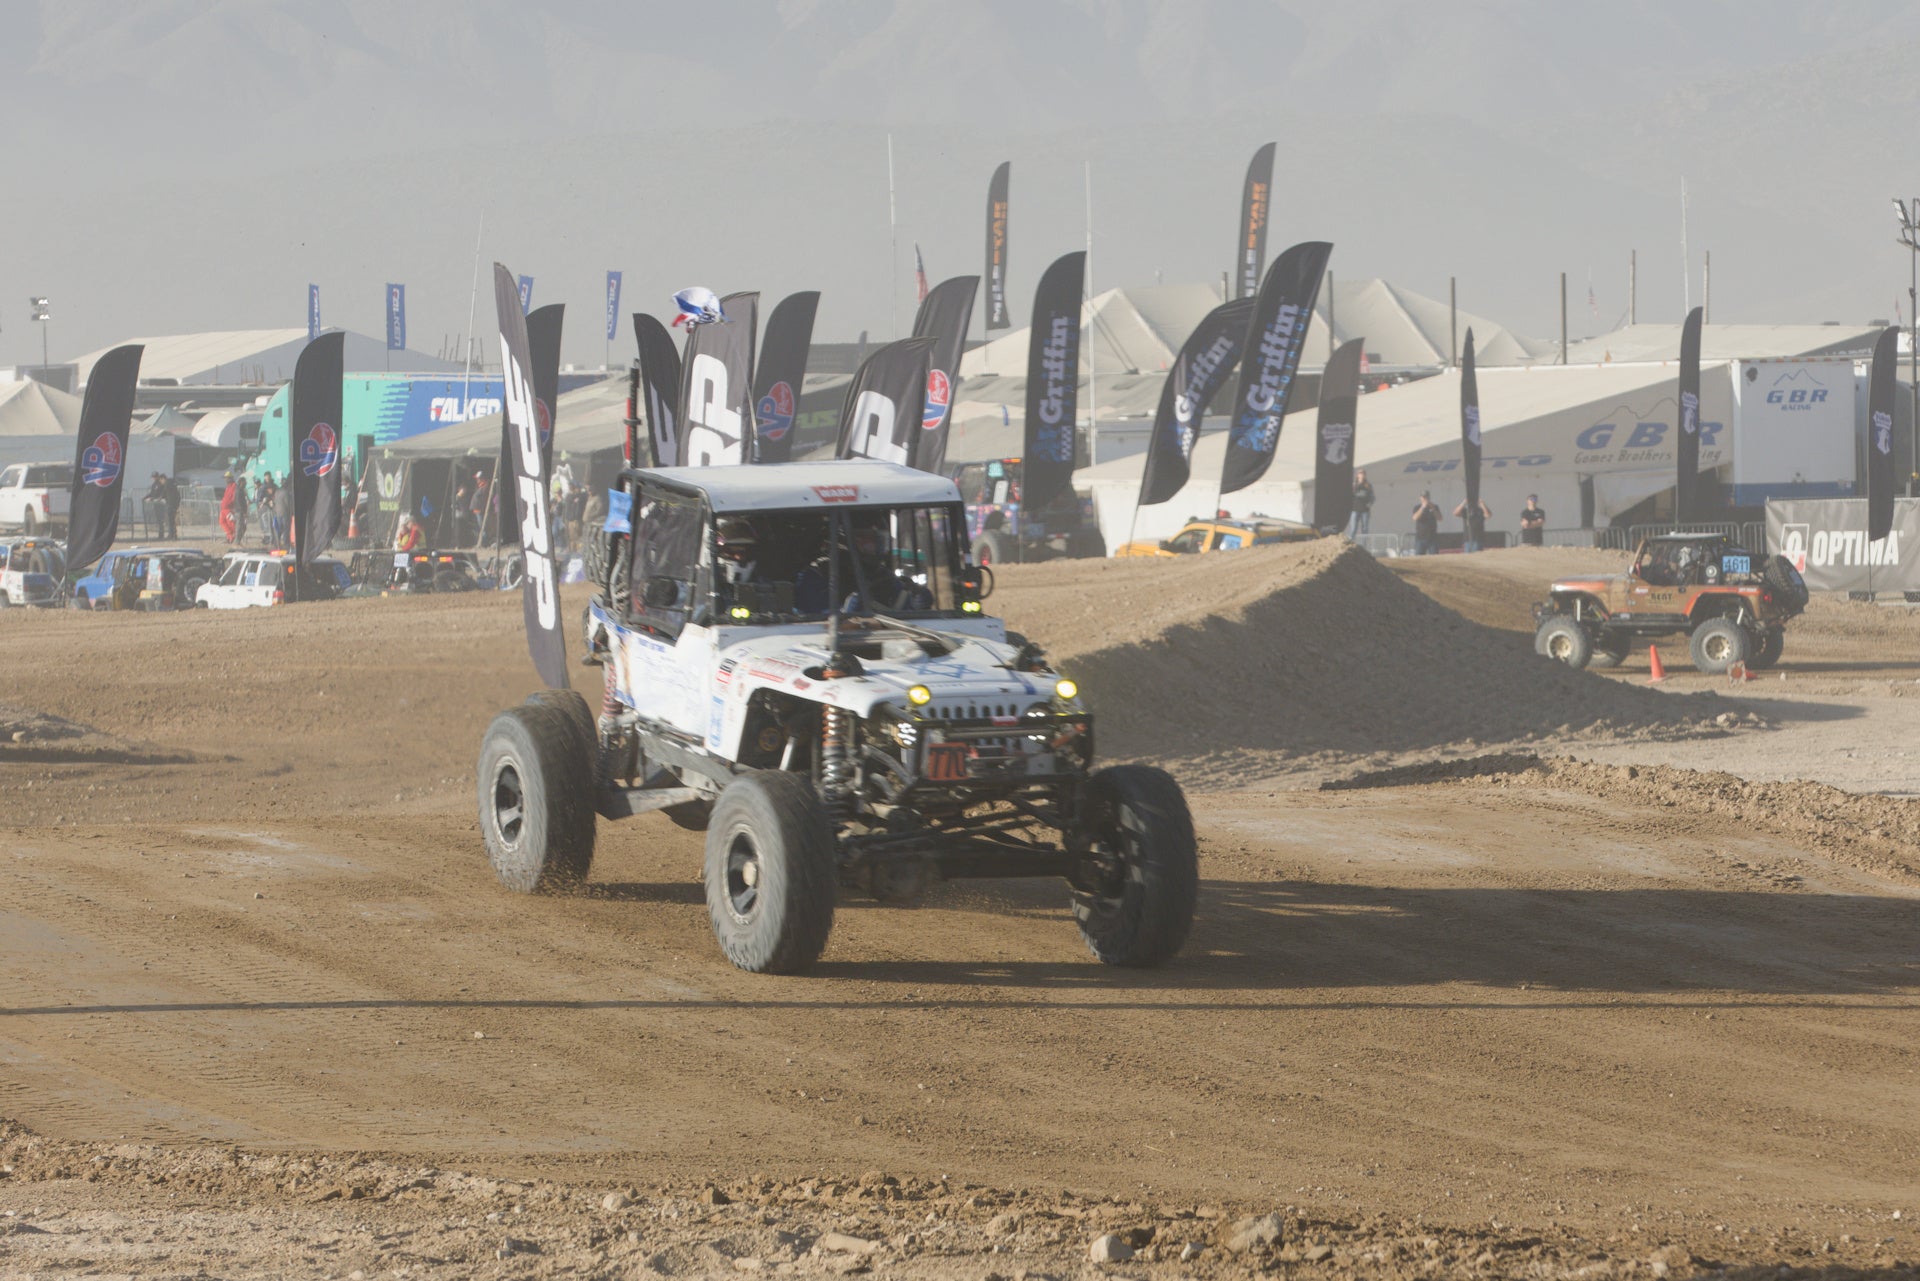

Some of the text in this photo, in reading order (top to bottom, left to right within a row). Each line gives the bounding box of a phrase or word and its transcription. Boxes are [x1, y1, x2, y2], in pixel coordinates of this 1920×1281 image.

[1039, 316, 1069, 424] Griffin
[1175, 336, 1234, 423] Griffin
[1246, 303, 1300, 412] Griffin
[1618, 449, 1672, 462] Brothers
[1811, 530, 1899, 567] OPTIMA
